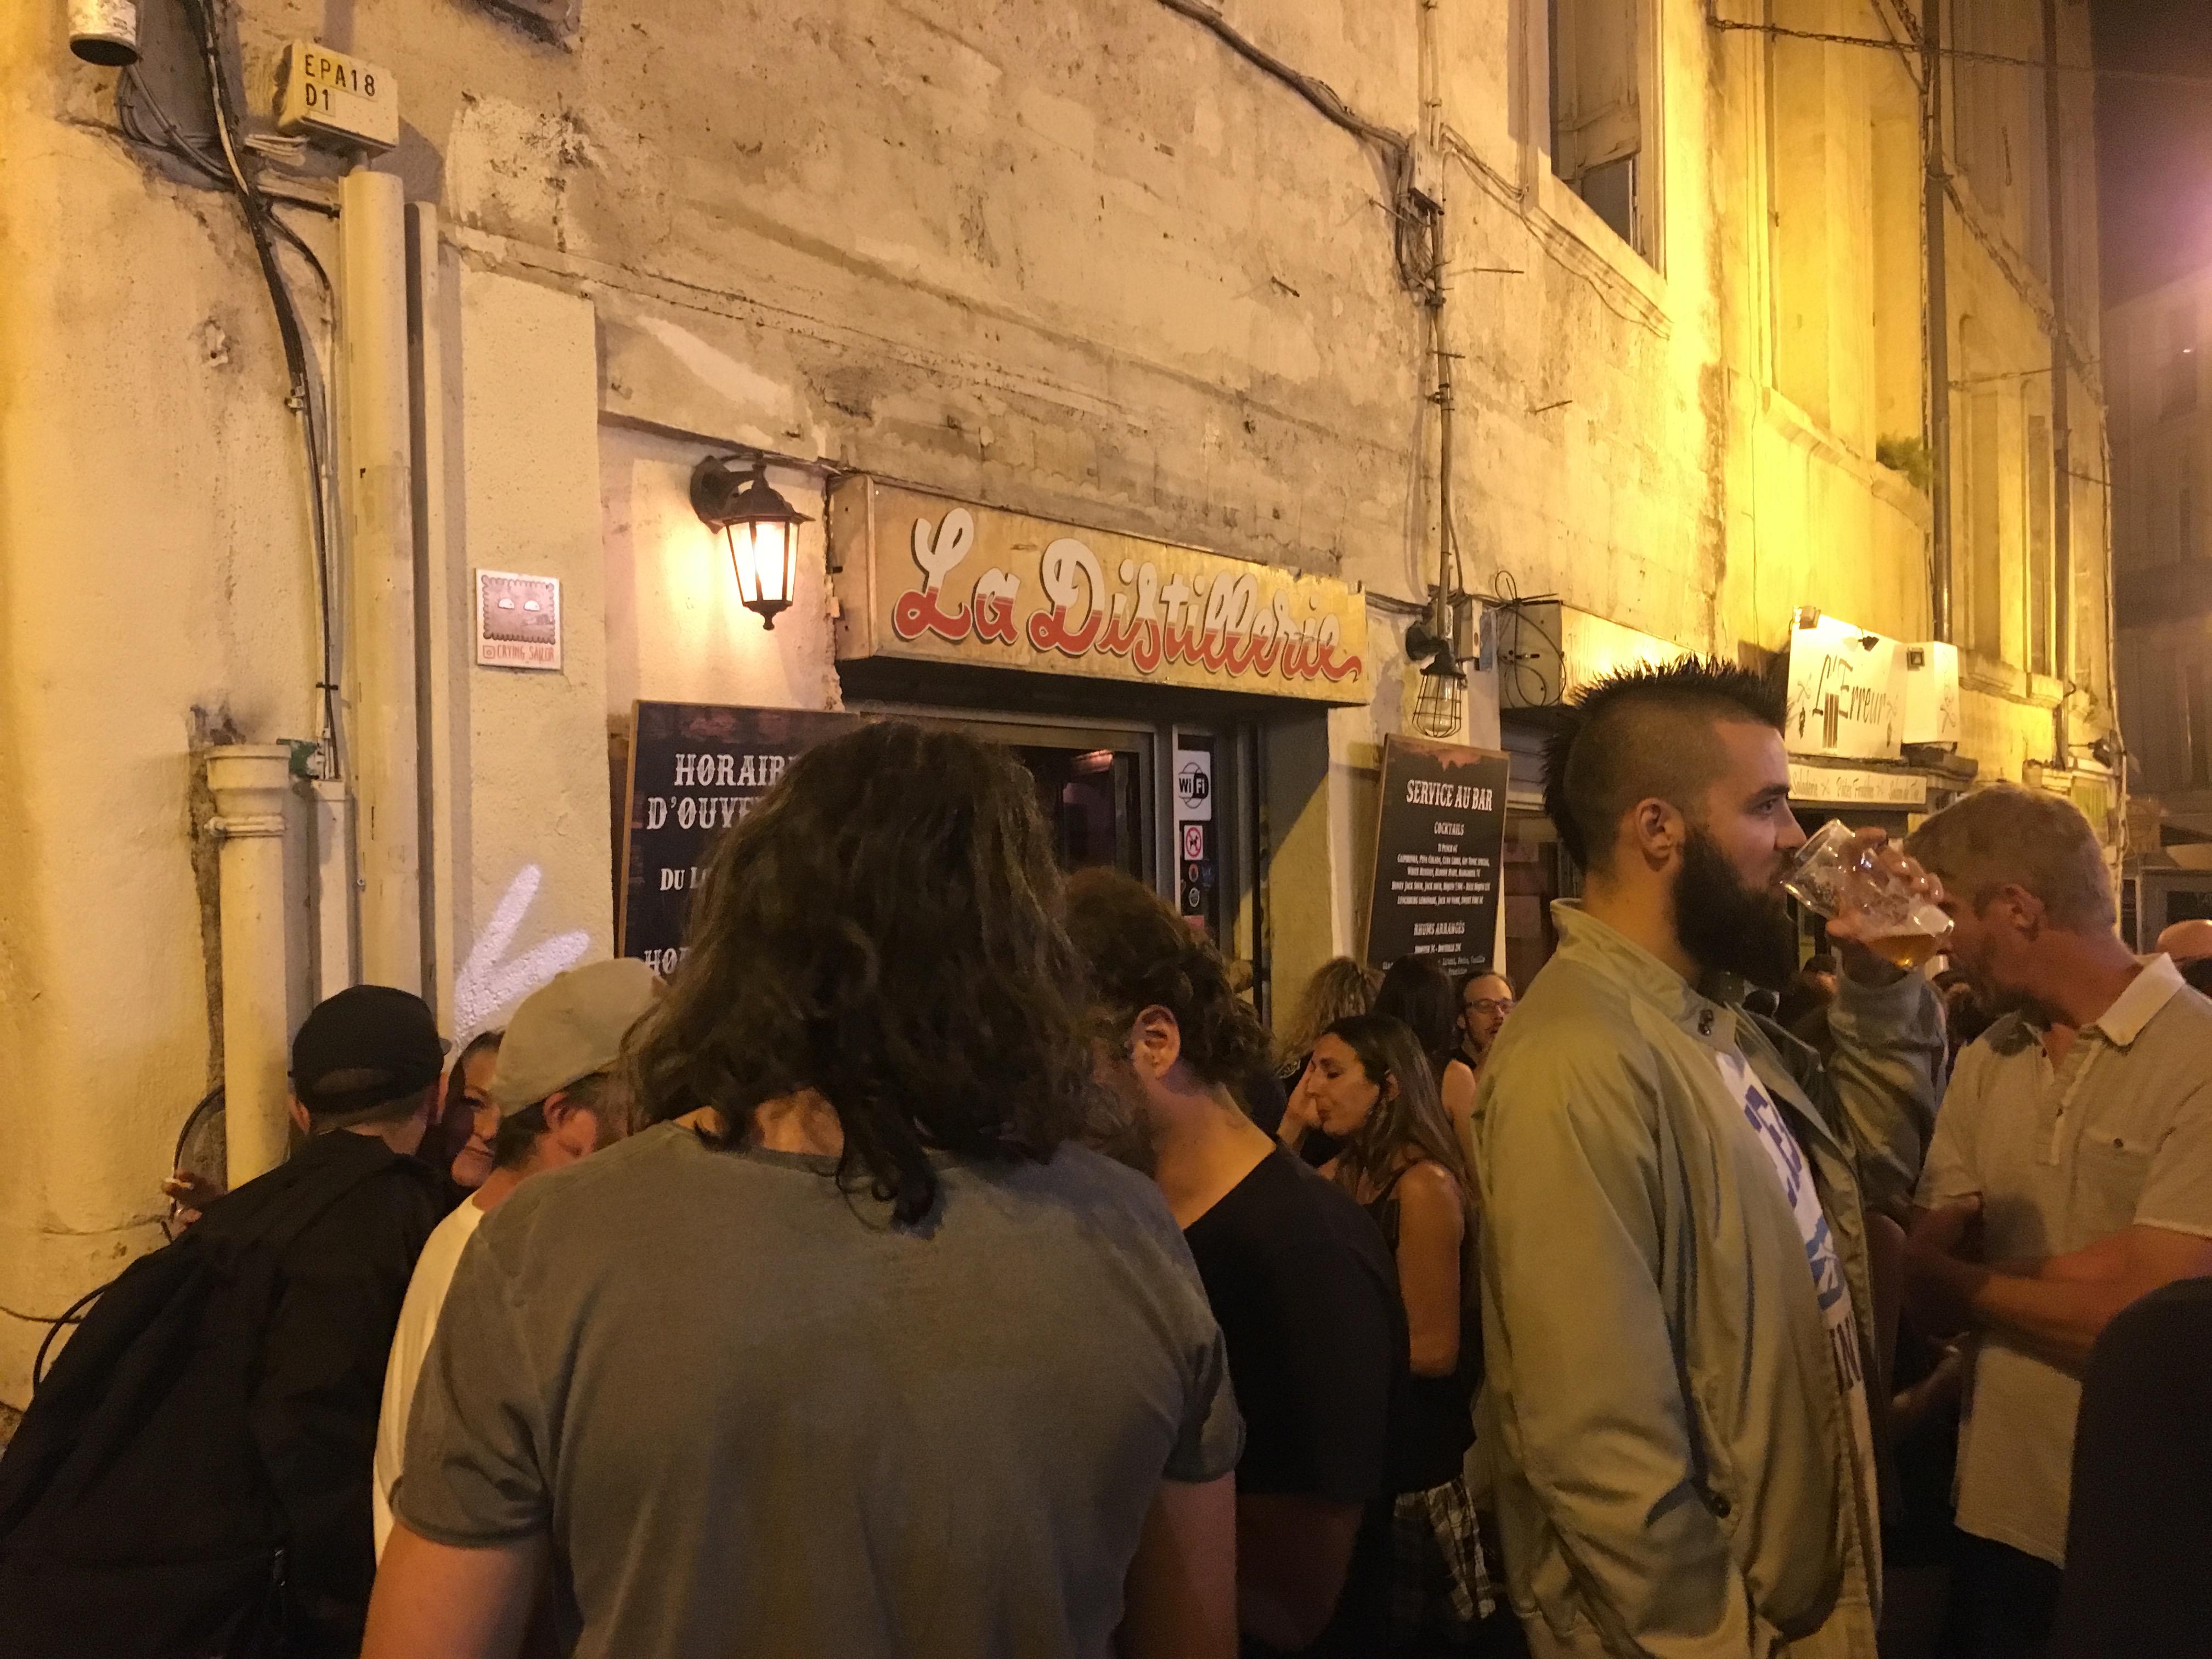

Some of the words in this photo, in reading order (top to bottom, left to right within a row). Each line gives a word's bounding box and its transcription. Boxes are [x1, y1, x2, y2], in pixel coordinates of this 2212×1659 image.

[305, 54, 375, 97] EPA18
[306, 83, 329, 110] D1
[893, 507, 1021, 645] La
[1027, 538, 1362, 684] Distillerie
[497, 645, 525, 659] CRYING
[674, 754, 795, 786] HORAIR
[1406, 779, 1454, 807] SERVICE
[1454, 785, 1471, 809] AU
[1471, 787, 1492, 811] BAR
[647, 796, 766, 830] D'OUVE
[1434, 821, 1464, 836] COCKTAILS
[660, 868, 685, 891] DU
[1414, 922, 1435, 936] RHUMS
